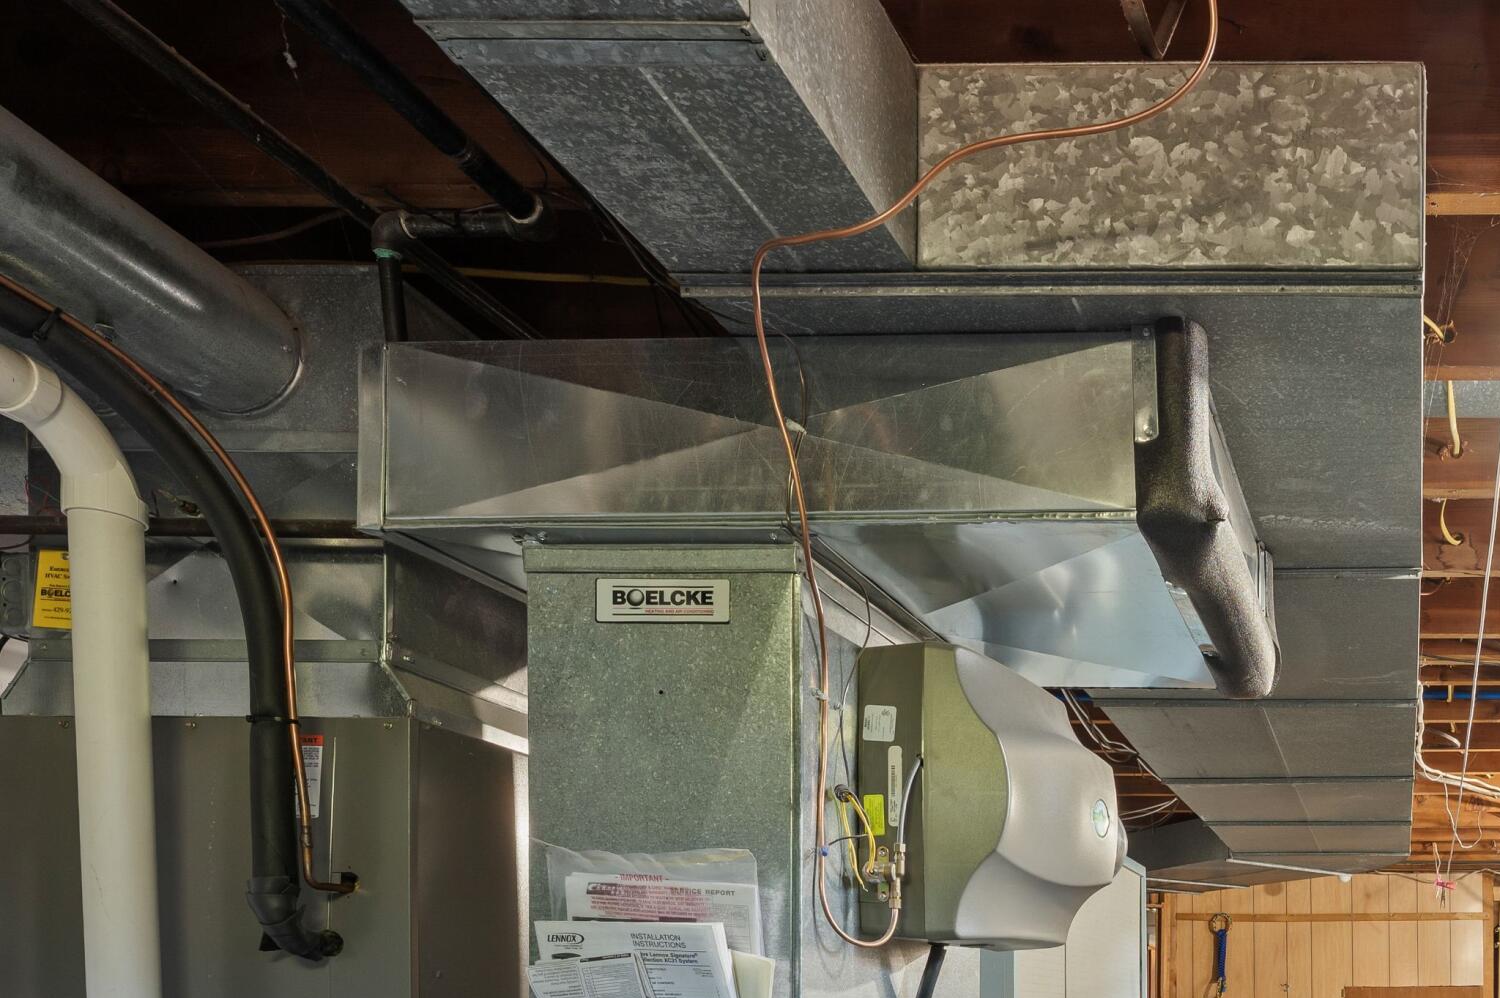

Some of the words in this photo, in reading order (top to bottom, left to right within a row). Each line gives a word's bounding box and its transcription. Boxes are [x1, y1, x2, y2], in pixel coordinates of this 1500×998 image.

[612, 589, 714, 606] BOELCKE
[620, 874, 664, 883] IMPORTANT
[705, 889, 736, 897] REPORT
[547, 934, 578, 943] LENNOX
[630, 933, 681, 942] INSTALLATION
[633, 941, 687, 949] INSTRUCTIONS
